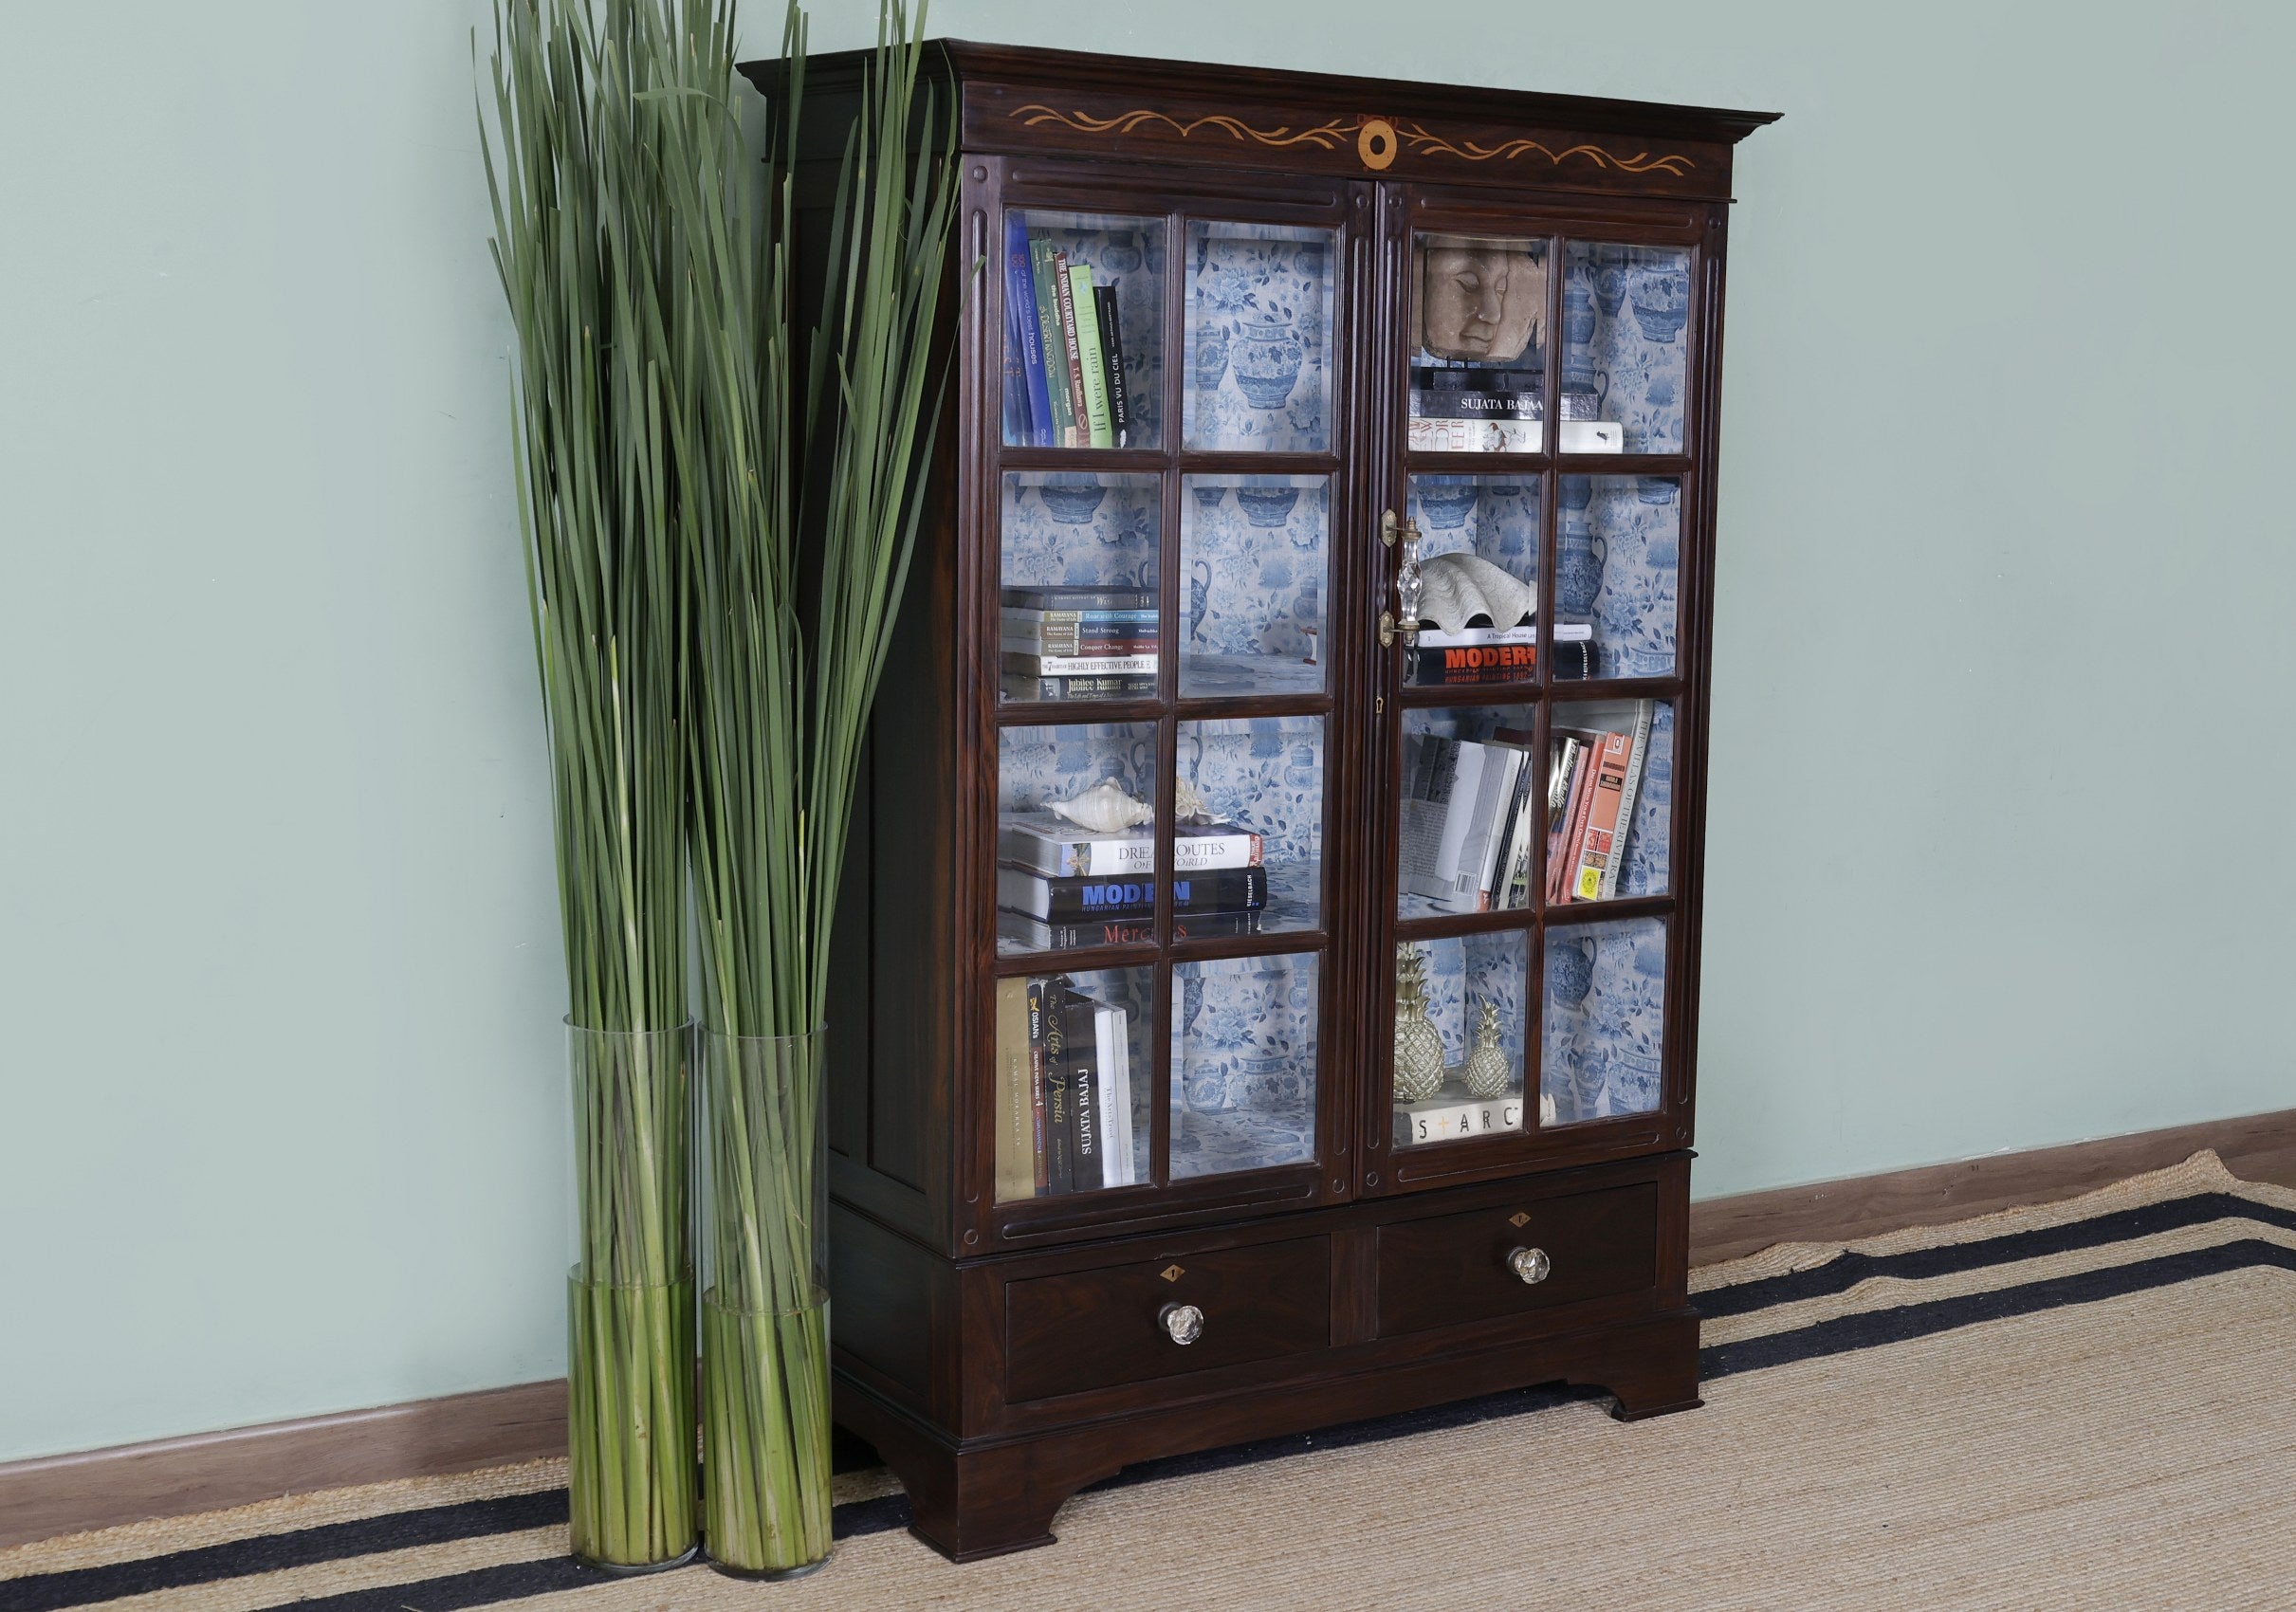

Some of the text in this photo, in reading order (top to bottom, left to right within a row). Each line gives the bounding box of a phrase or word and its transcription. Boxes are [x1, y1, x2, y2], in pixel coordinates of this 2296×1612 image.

[1057, 259, 1079, 360] THE INDIAN COURTYARD HOUSE
[1029, 332, 1038, 365] houses
[1087, 347, 1099, 375] rain
[1113, 373, 1121, 386] DU
[1064, 387, 1073, 415] morgan
[1093, 378, 1104, 410] were
[1114, 387, 1123, 399] VU
[1116, 400, 1125, 424] PARIS
[1460, 398, 1503, 411] SUJATA
[1093, 421, 1106, 432] If
[1113, 612, 1137, 620] Courage
[1068, 661, 1090, 671] HIGHLY
[1090, 661, 1122, 670] EFFECTIVE
[1123, 660, 1145, 669] PEOPLE
[1067, 678, 1094, 693] Jubilee
[1096, 677, 1123, 691] Kumar
[1175, 842, 1225, 856] OUTES
[1175, 857, 1208, 867] ORLD
[1081, 903, 1120, 912] HUNGARIAN
[1049, 994, 1057, 1010] The
[1046, 1015, 1063, 1055] Arts
[1048, 1072, 1066, 1125] Persia
[1077, 1069, 1092, 1155] SUJATA BAJAJ
